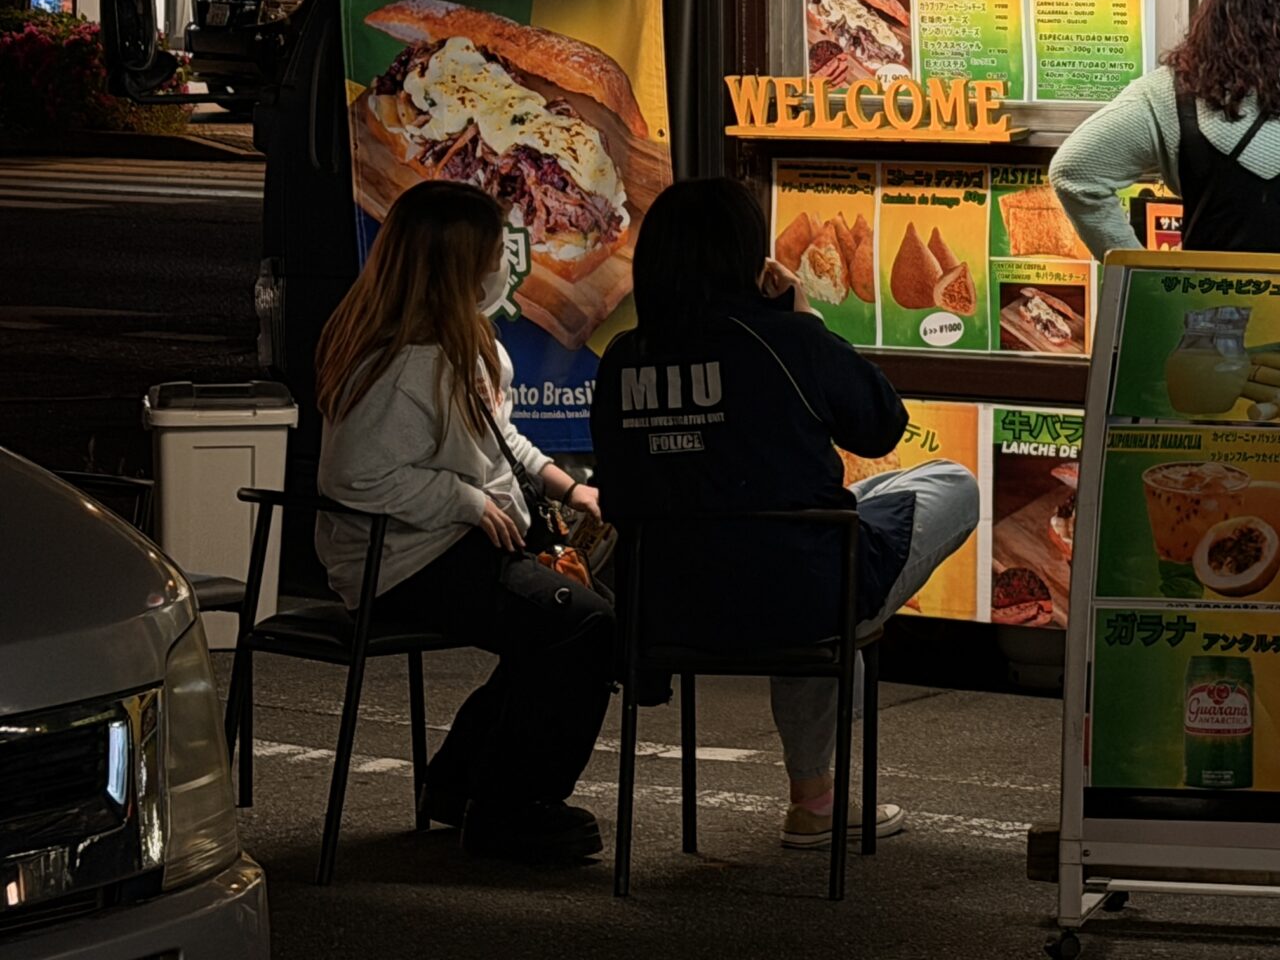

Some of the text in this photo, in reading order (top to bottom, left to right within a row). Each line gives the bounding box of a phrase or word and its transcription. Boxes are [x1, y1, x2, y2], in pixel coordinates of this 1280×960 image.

[1039, 33, 1074, 41] ESPECIAL
[1104, 35, 1129, 43] MISTO
[1041, 60, 1076, 68] GIGANTE
[1109, 62, 1135, 70] MISTO
[724, 75, 1013, 133] WELCOME
[991, 167, 1045, 185] PASTEL
[621, 360, 723, 412] MIU
[652, 434, 702, 451] POLICE
[1002, 441, 1078, 458] LANCHE DE
[1105, 613, 1197, 646] ガラナ
